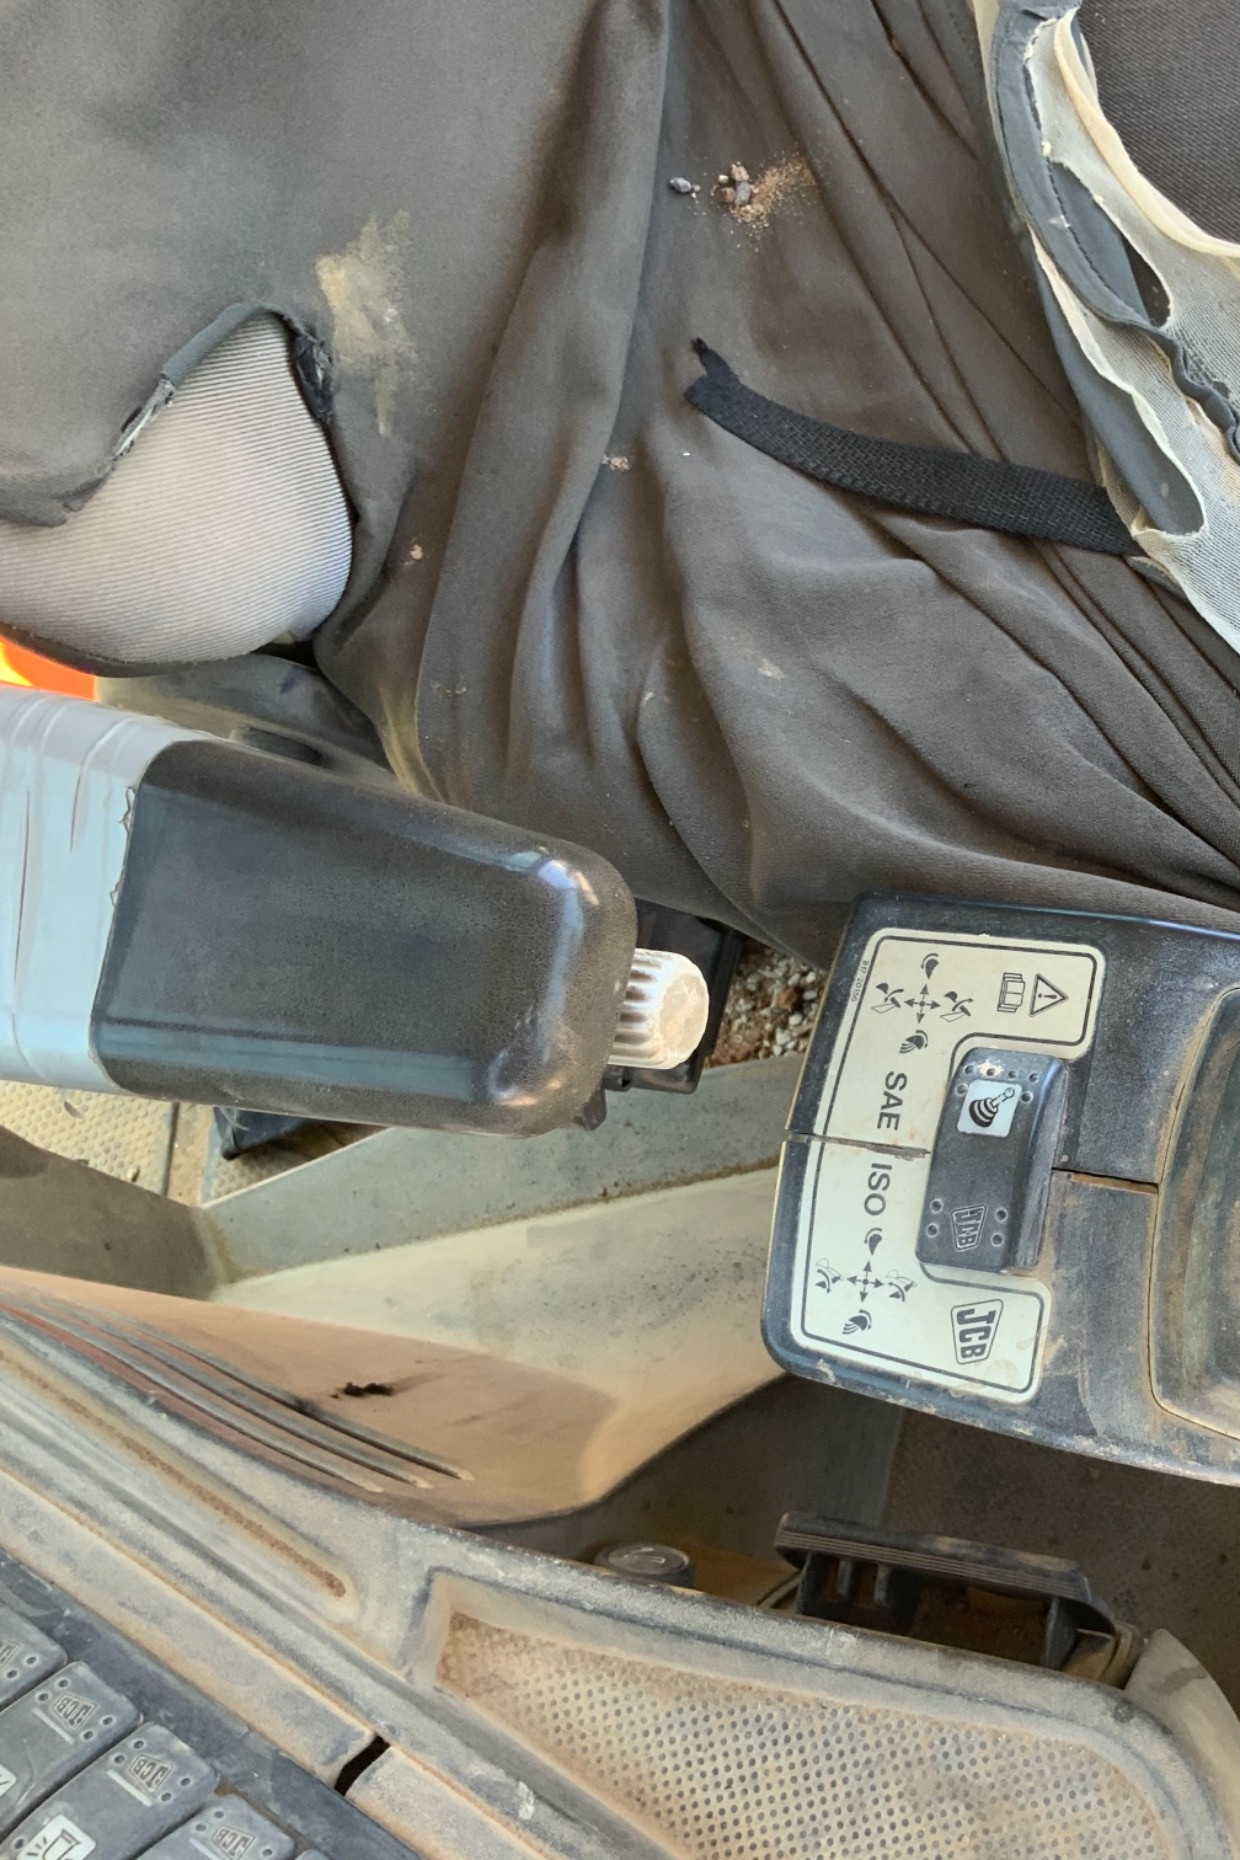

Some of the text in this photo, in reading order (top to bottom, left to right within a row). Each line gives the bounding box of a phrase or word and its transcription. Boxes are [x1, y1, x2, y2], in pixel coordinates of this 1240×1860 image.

[876, 1070, 908, 1131] SAE
[864, 1162, 893, 1216] ISO
[954, 1208, 984, 1247] JCB
[956, 1308, 997, 1359] JCB
[56, 1696, 92, 1726] JCB
[132, 1758, 169, 1789] JCB
[216, 1828, 251, 1857] JCB
